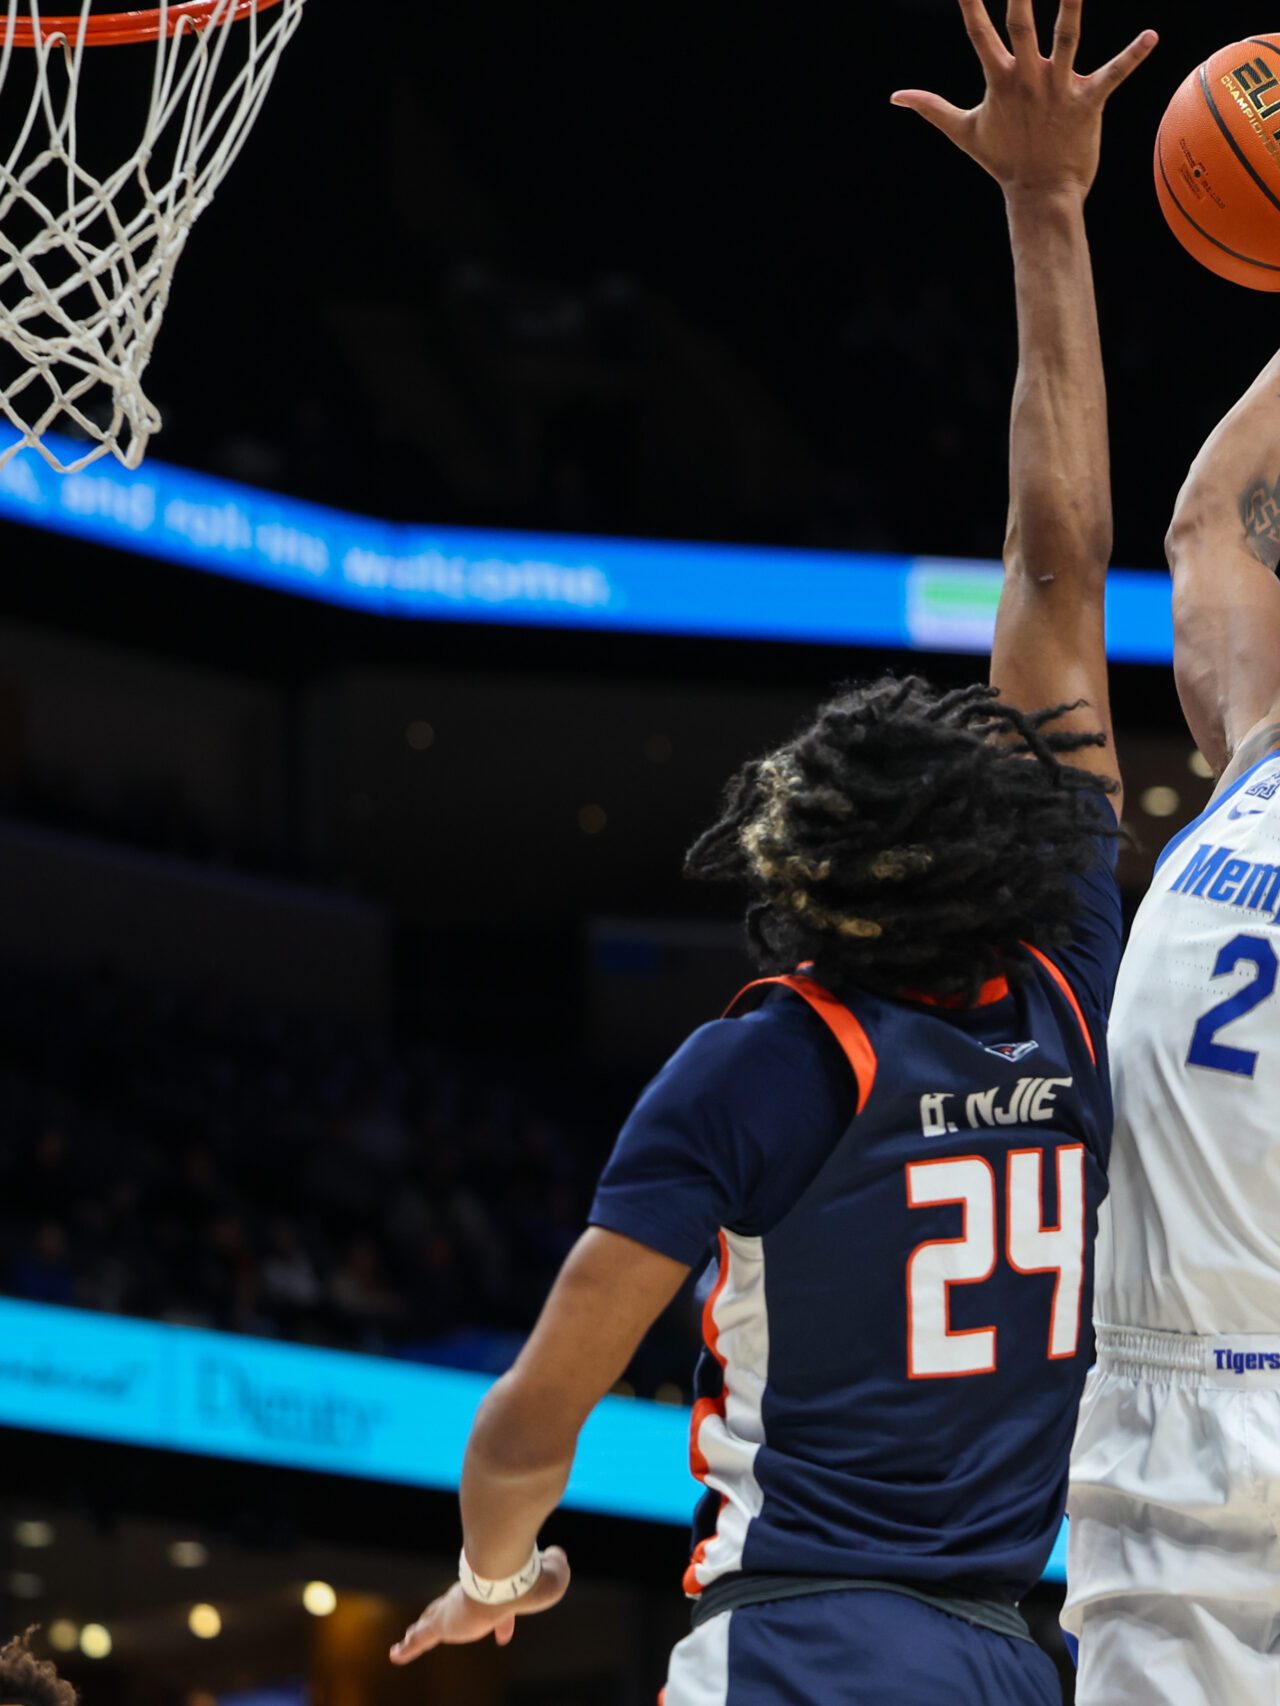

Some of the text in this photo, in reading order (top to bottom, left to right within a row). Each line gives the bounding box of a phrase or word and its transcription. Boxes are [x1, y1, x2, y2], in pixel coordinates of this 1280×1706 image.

[1185, 933, 1280, 1080] 2
[966, 1076, 1073, 1130] NJIE
[905, 1143, 1084, 1379] 24
